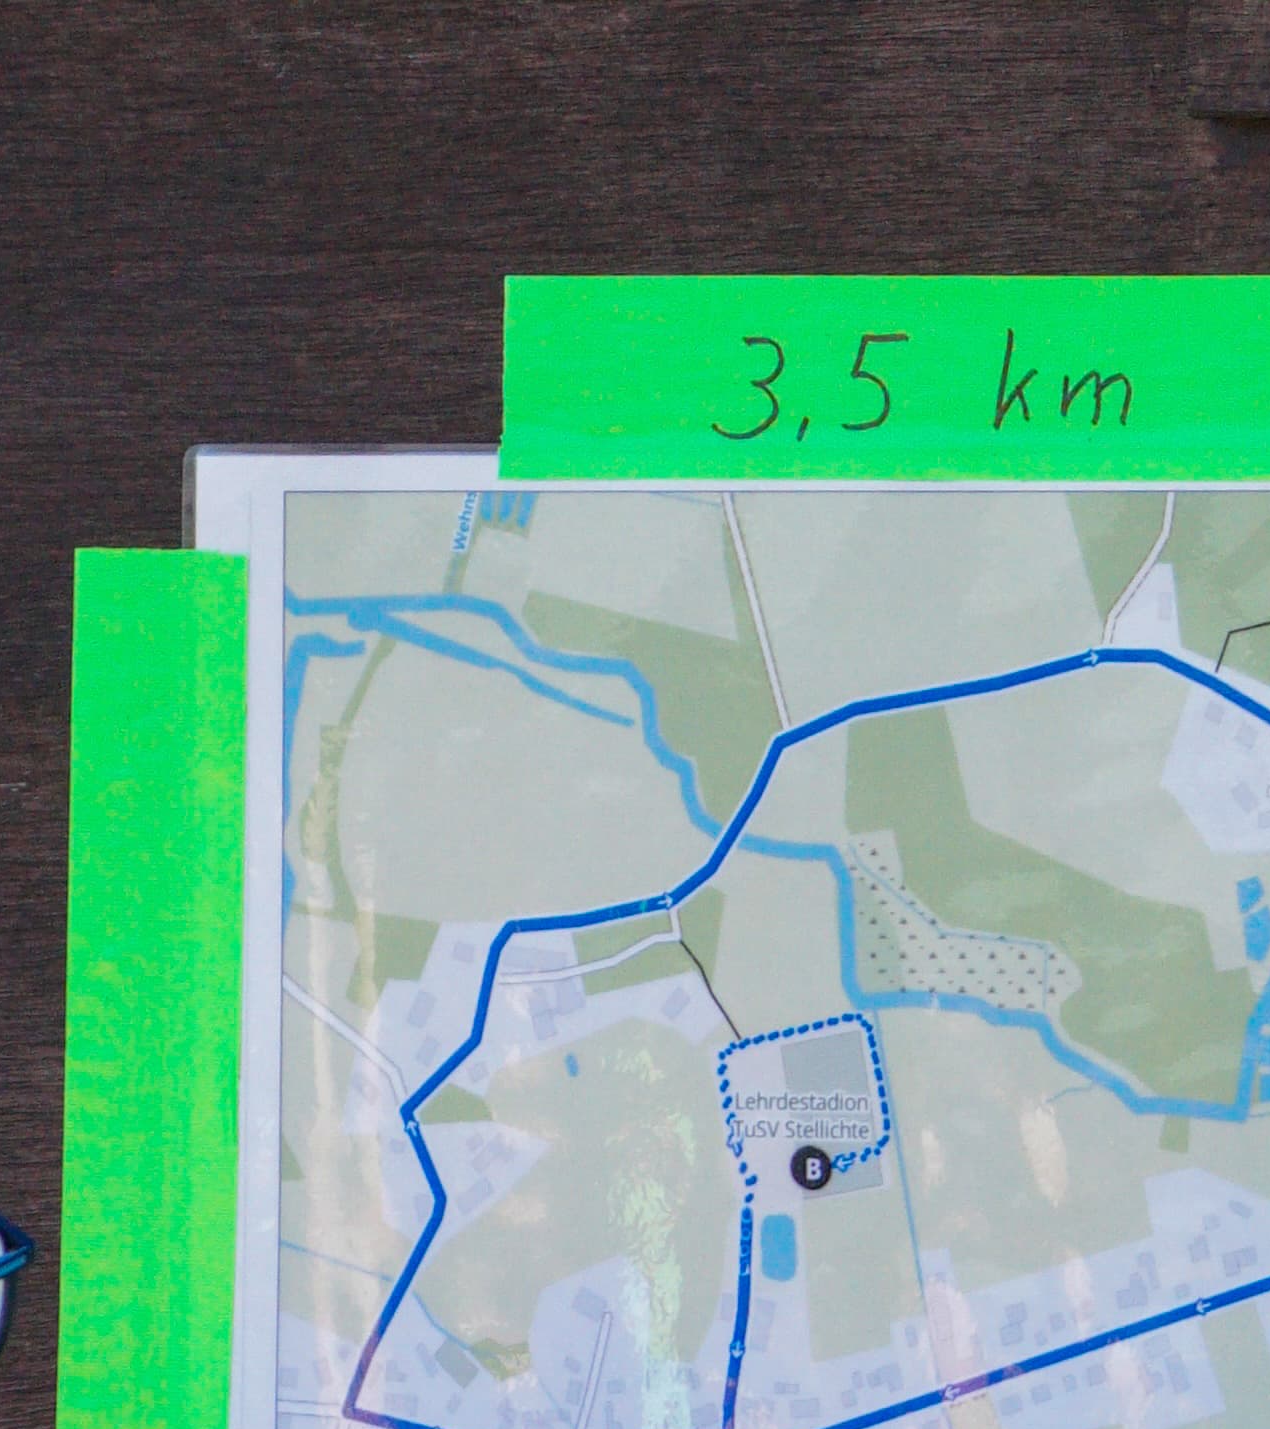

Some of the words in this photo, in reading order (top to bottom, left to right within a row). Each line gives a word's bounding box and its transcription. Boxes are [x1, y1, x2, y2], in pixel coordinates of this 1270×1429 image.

[711, 333, 909, 442] 3,5
[993, 328, 1132, 431] km
[735, 1091, 869, 1111] Lehrdestadion
[734, 1119, 780, 1139] TuSV
[785, 1119, 870, 1140] Stellichte
